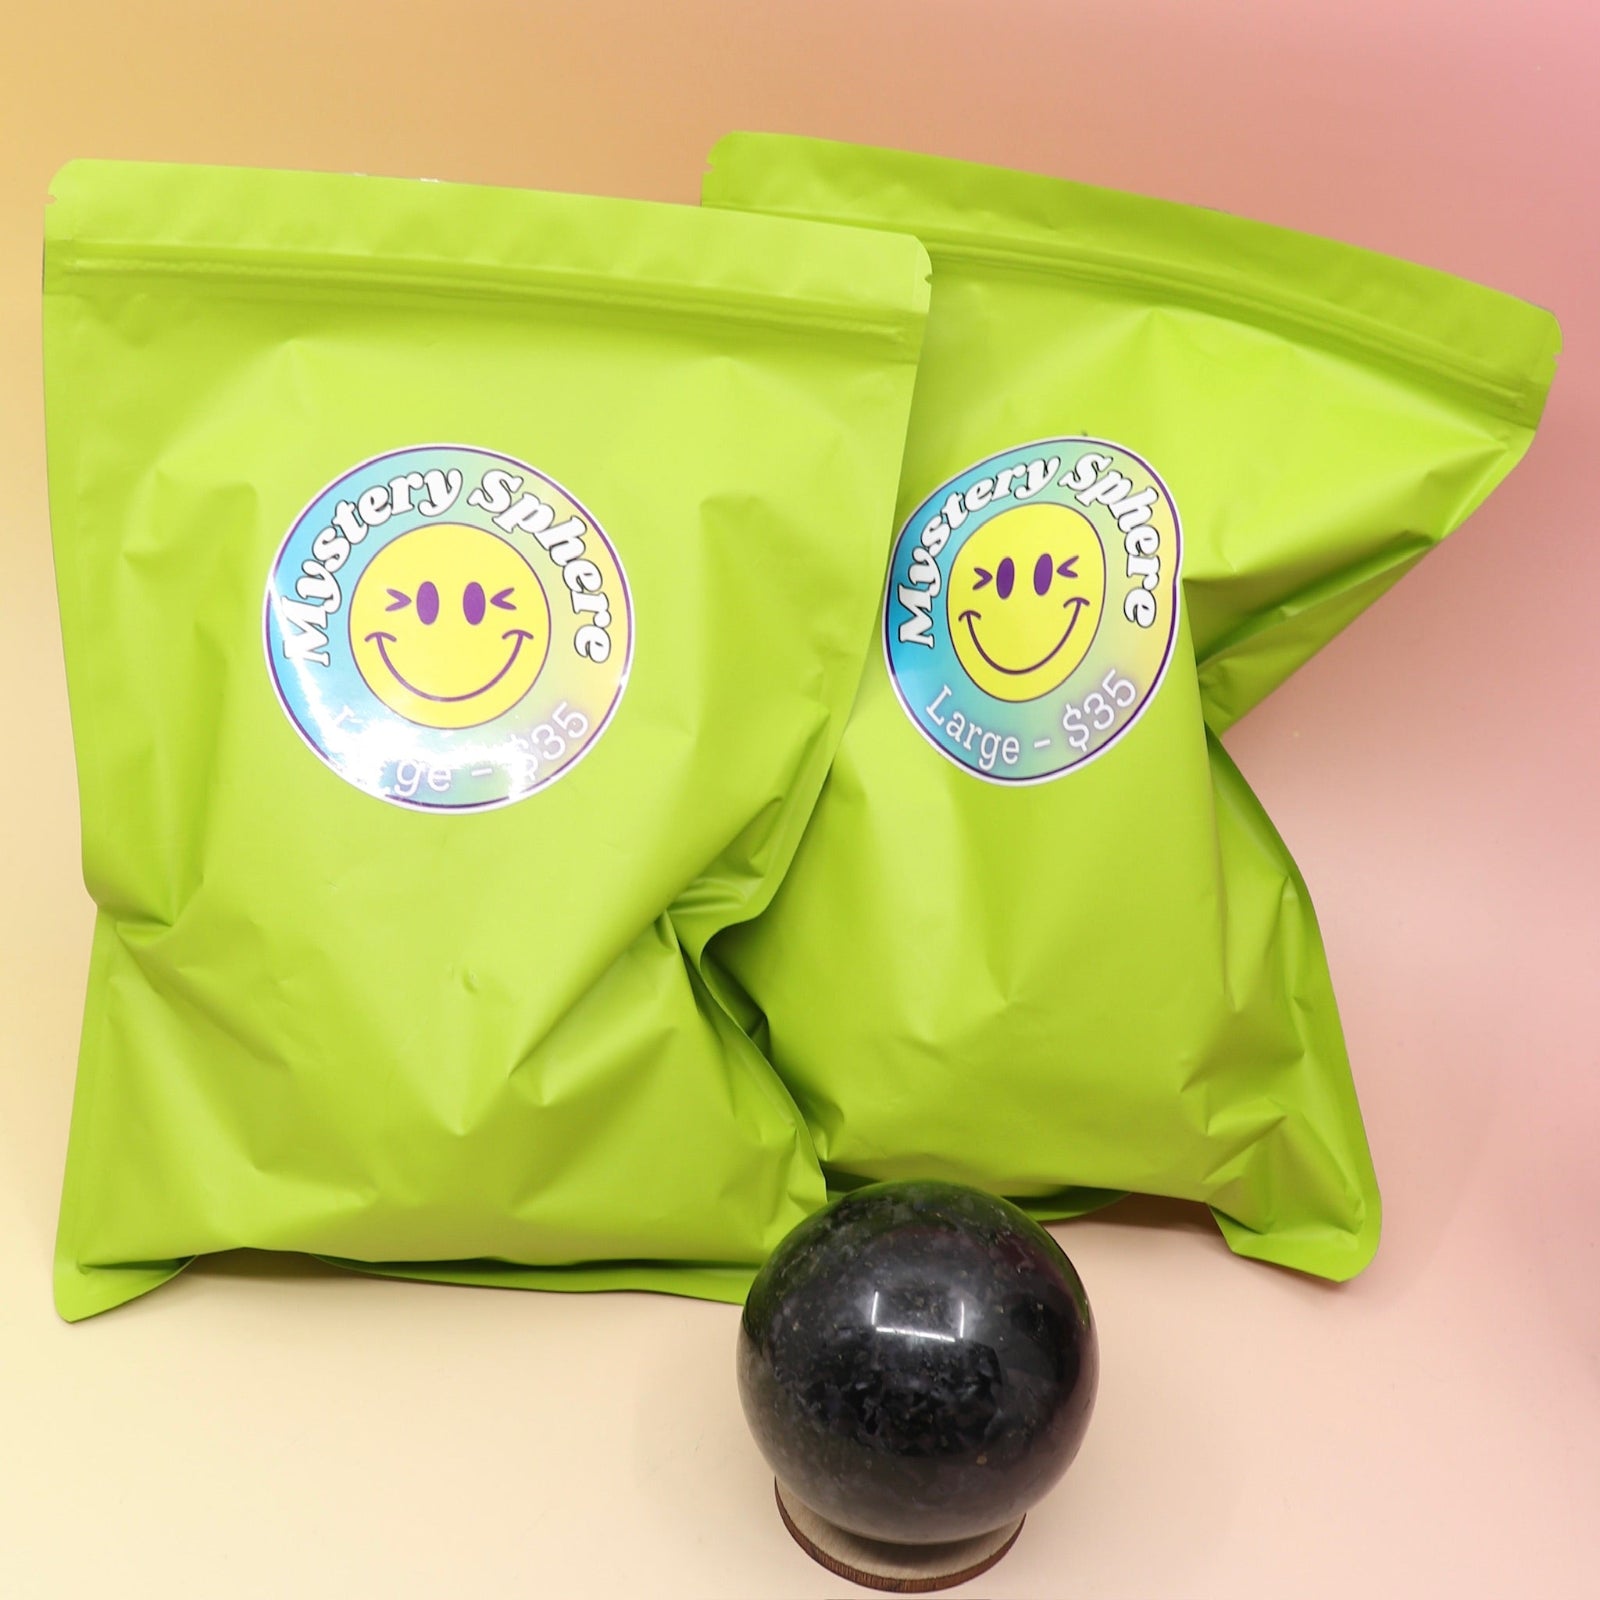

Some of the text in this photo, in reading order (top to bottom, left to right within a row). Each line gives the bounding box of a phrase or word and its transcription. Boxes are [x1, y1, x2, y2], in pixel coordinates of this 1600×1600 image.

[282, 468, 612, 667] Mystery Sphere
[897, 453, 1161, 650] Mystery Sphere
[924, 684, 1020, 771] Large
[1062, 669, 1138, 752] $35
